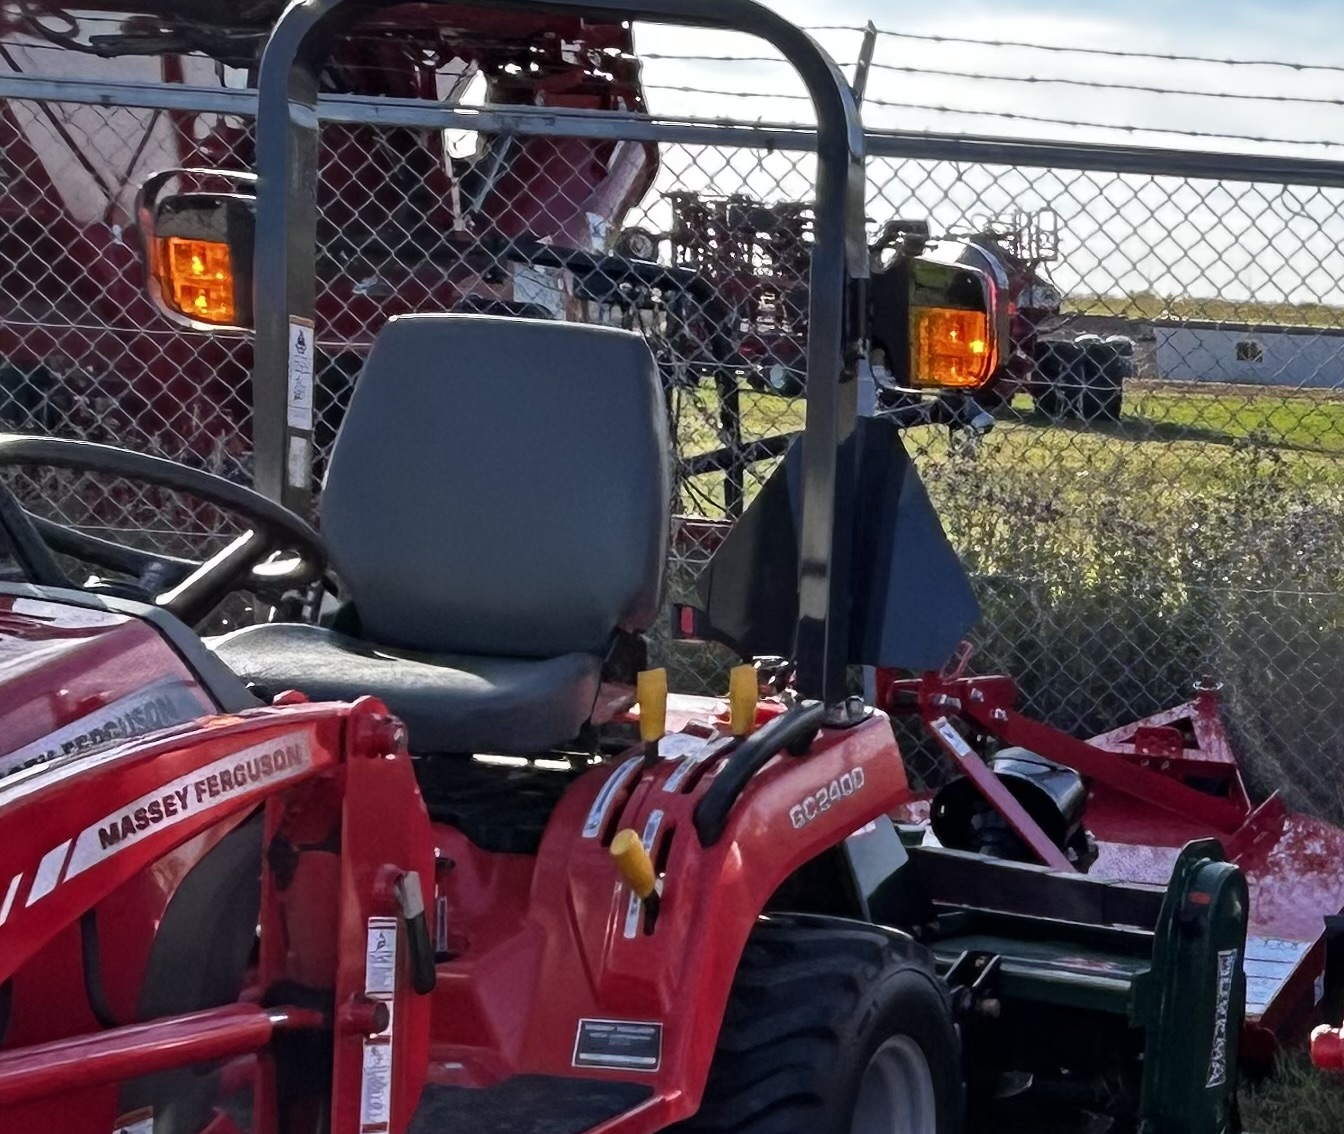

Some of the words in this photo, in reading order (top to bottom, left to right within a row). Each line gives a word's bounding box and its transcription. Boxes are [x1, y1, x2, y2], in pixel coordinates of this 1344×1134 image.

[97, 785, 189, 850] MASSEY
[194, 743, 303, 803] FERGUSON
[789, 766, 865, 829] GC2400
